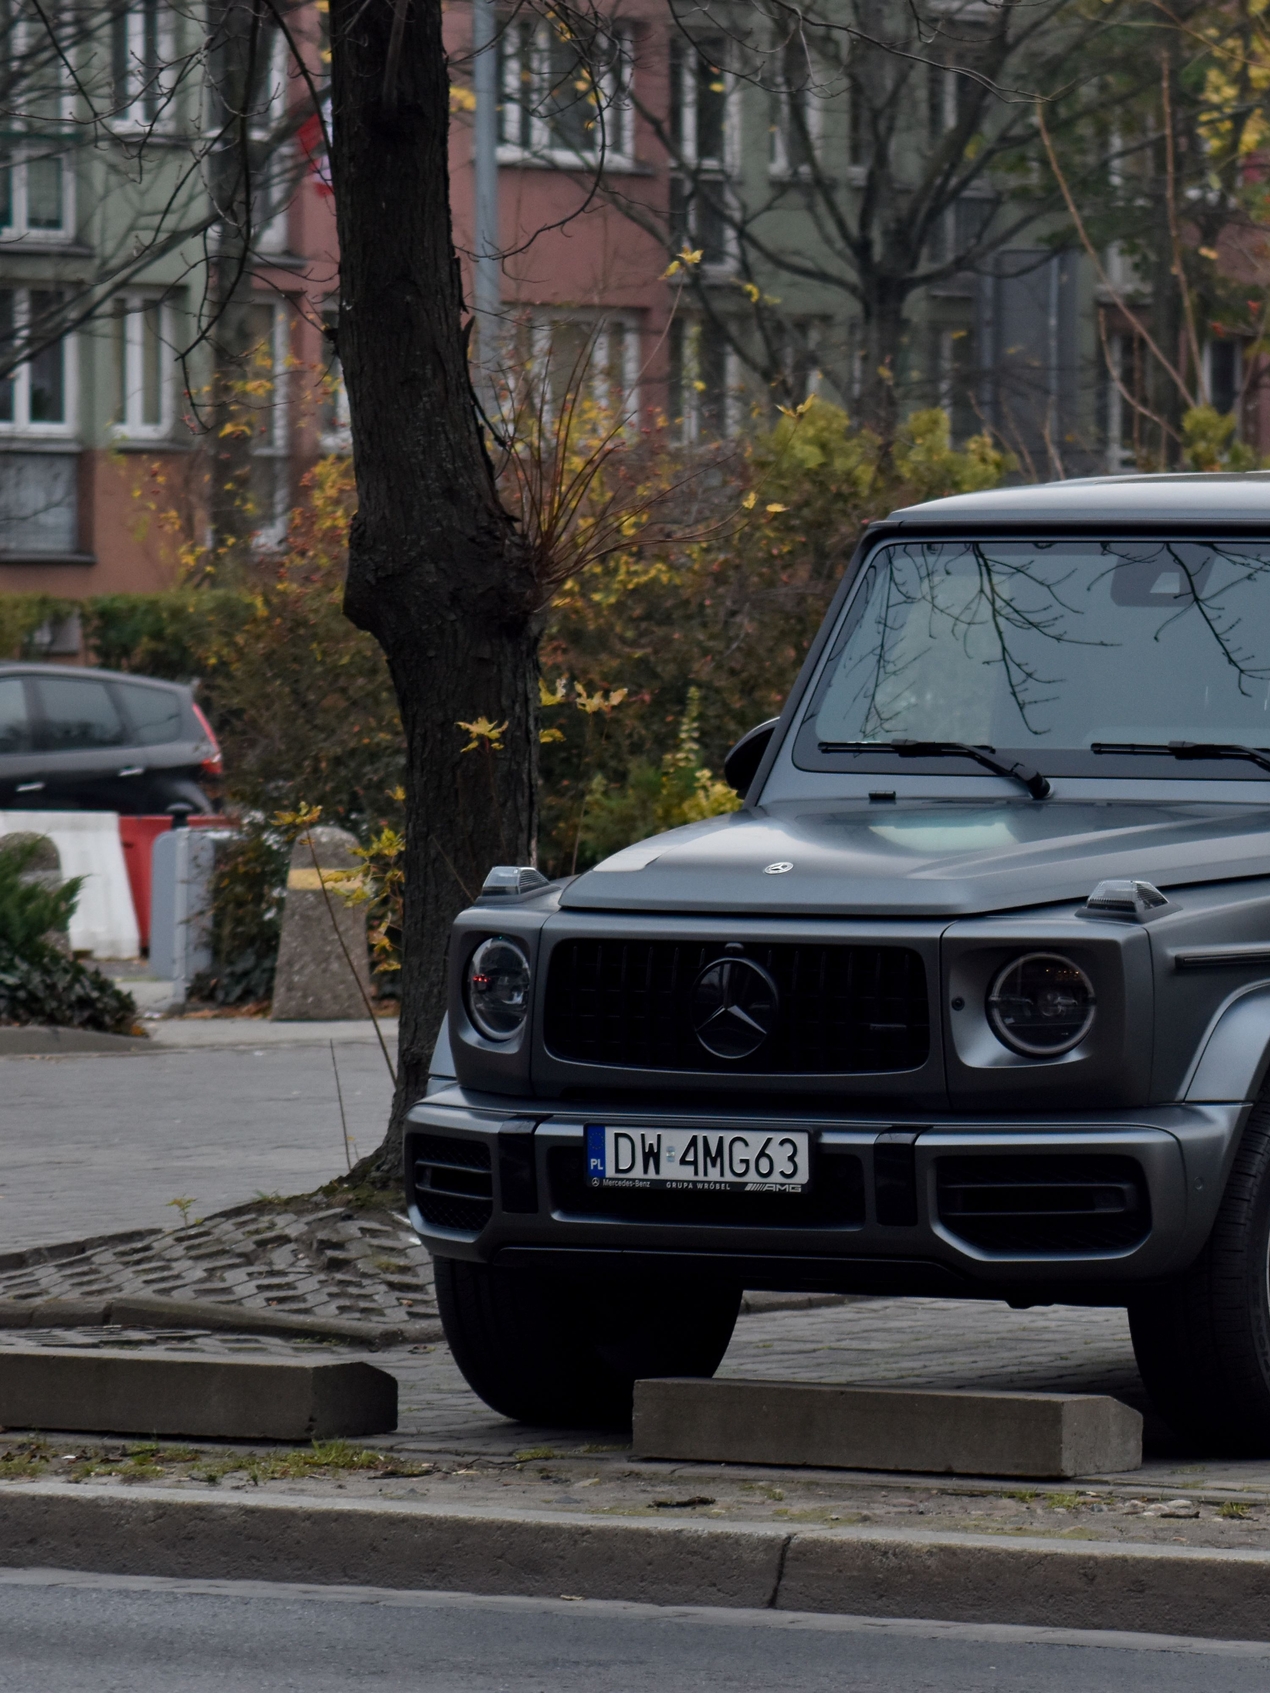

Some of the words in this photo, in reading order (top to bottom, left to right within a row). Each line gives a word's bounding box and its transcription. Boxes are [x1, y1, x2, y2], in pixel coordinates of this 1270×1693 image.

[614, 1132, 661, 1175] DW
[679, 1134, 798, 1179] 4MG63
[590, 1159, 604, 1170] PL
[602, 1178, 651, 1188] Mercedes-Benz
[697, 1181, 731, 1190] WRÓBEL
